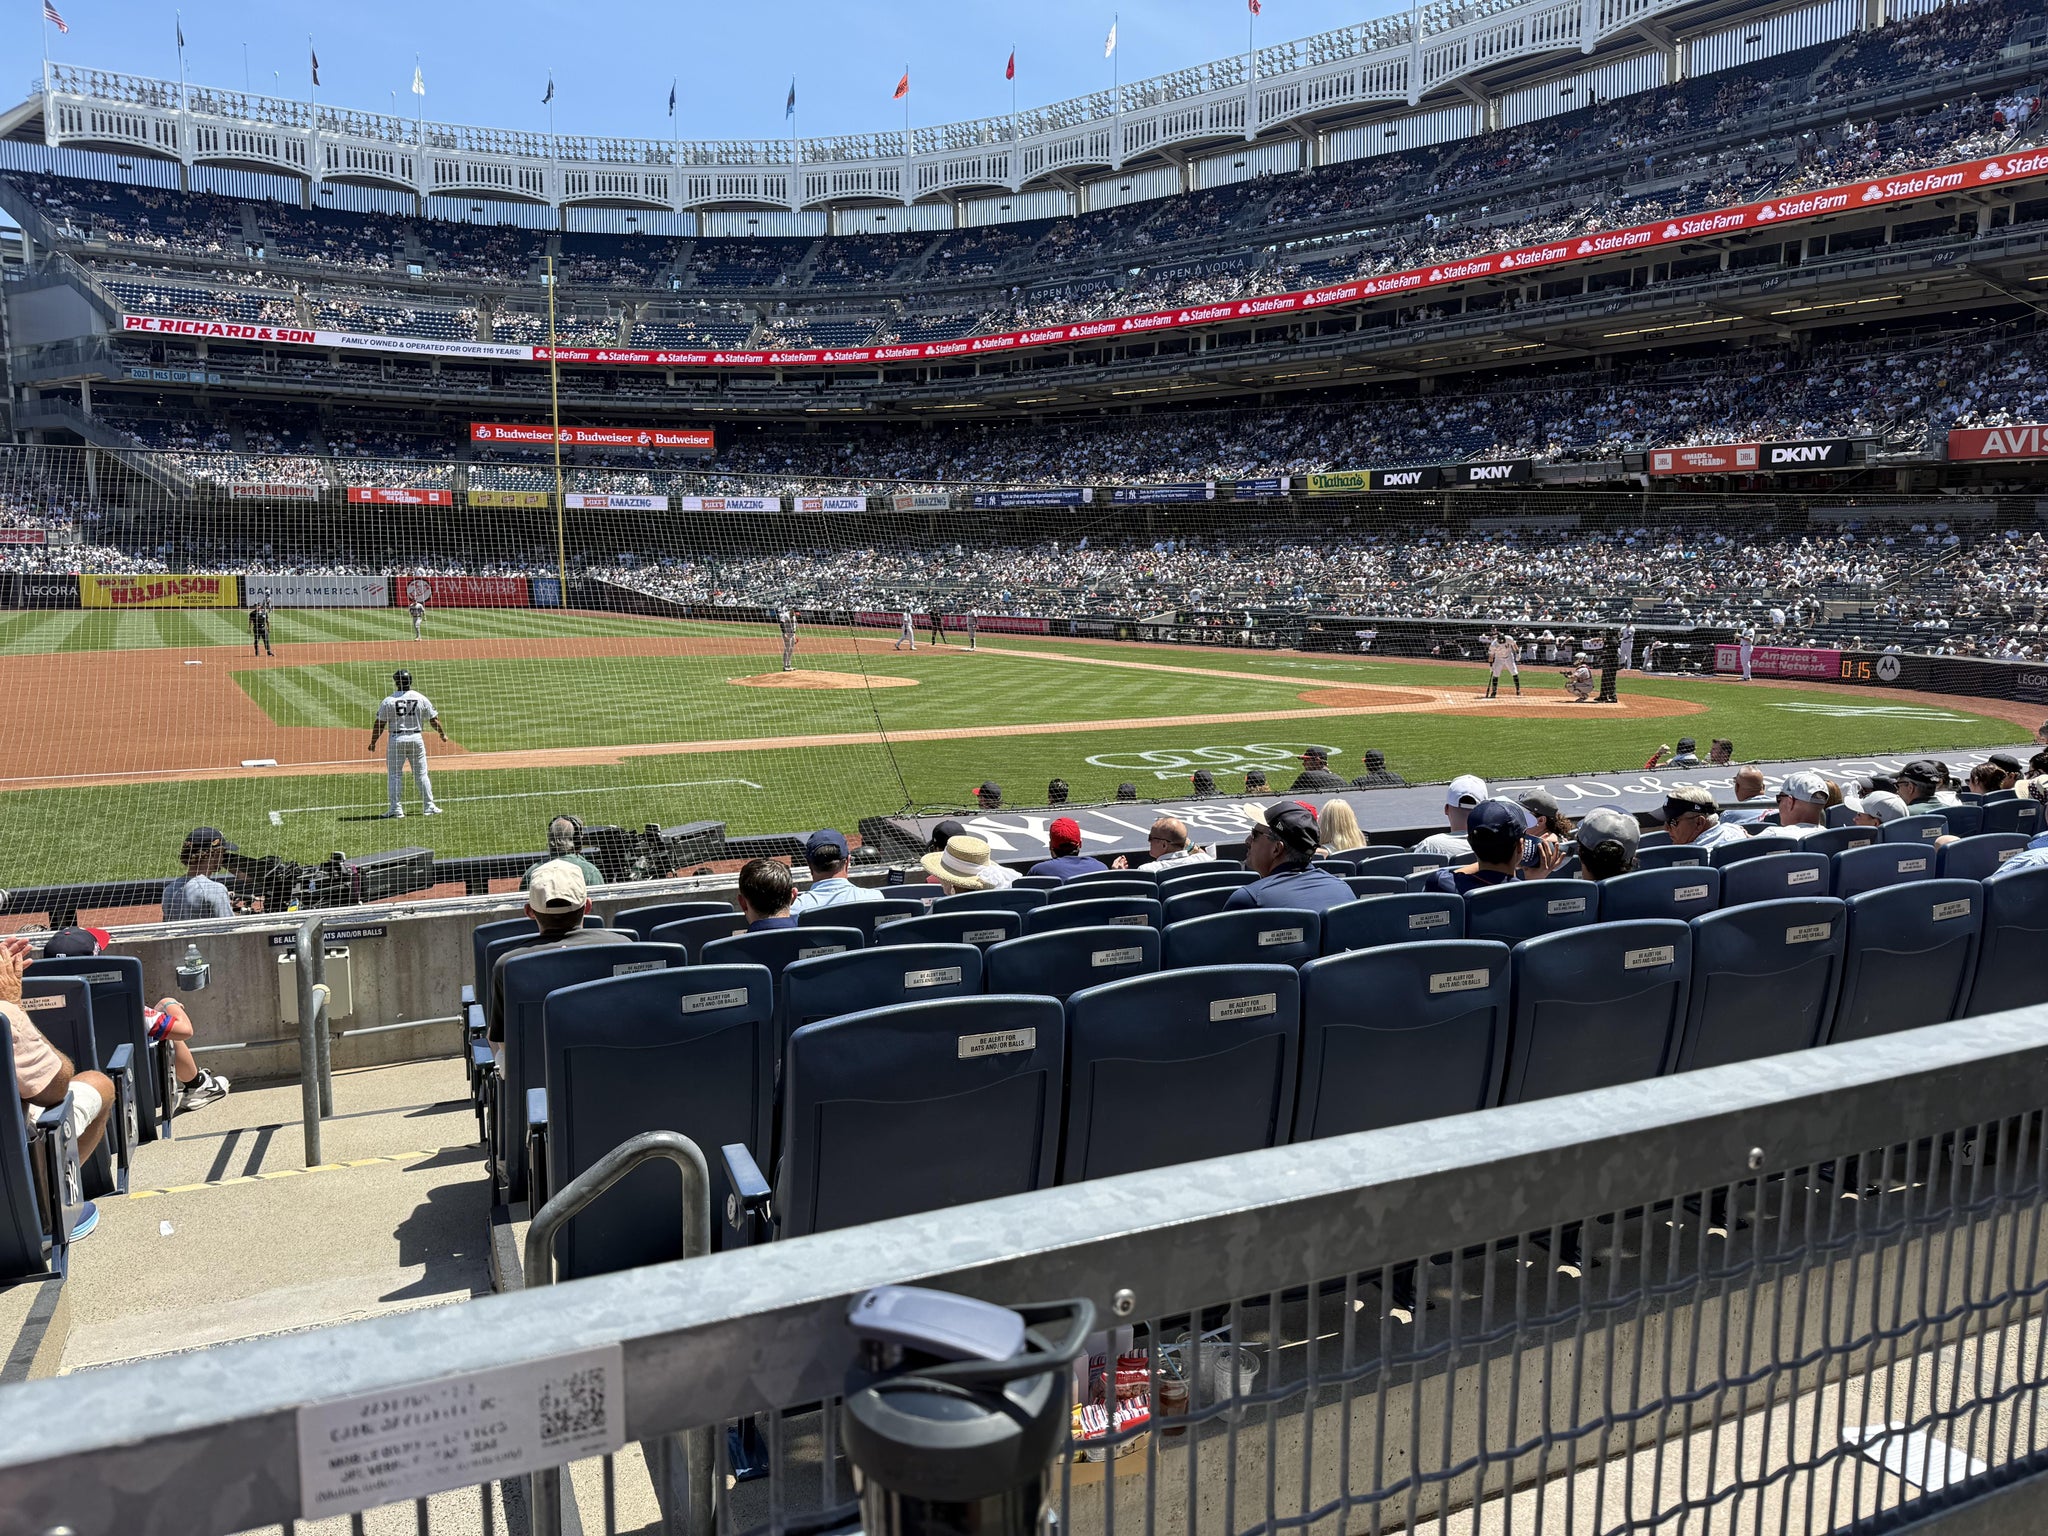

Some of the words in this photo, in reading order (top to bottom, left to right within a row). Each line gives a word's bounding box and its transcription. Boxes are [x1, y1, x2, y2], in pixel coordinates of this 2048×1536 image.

[1933, 252, 1955, 262] 1947
[1205, 258, 1244, 273] VODKA
[1030, 288, 1062, 300] ASPEN
[1074, 280, 1108, 293] VODKA
[125, 316, 156, 332] P.C.
[158, 319, 255, 338] RICHARD
[258, 328, 272, 340] &
[276, 329, 315, 343] SON
[341, 337, 369, 345] FAMILY
[370, 339, 398, 348] OWNED
[405, 341, 444, 352] OPERATED
[495, 347, 521, 356] YEARS!
[133, 370, 148, 379] 2021
[155, 371, 168, 380] MLS
[173, 372, 186, 380] CUP
[495, 428, 554, 439] Budweiser
[576, 432, 633, 442] Budweiser
[656, 434, 709, 444] Budweiser
[1771, 446, 1832, 463] DKNY
[1384, 472, 1422, 486] DKNY
[1470, 465, 1513, 480] DKNY
[1312, 474, 1365, 490] Nathan's
[234, 485, 262, 495] Parts
[610, 498, 651, 507] AMAZING
[726, 500, 763, 509] AMAZING
[824, 500, 858, 508] AMAZING
[25, 586, 78, 596] LEGORA
[468, 581, 516, 594] WEBB
[1760, 651, 1818, 662] America's
[1751, 660, 1776, 668] Best
[1779, 660, 1826, 672] Network
[395, 699, 418, 716] 67
